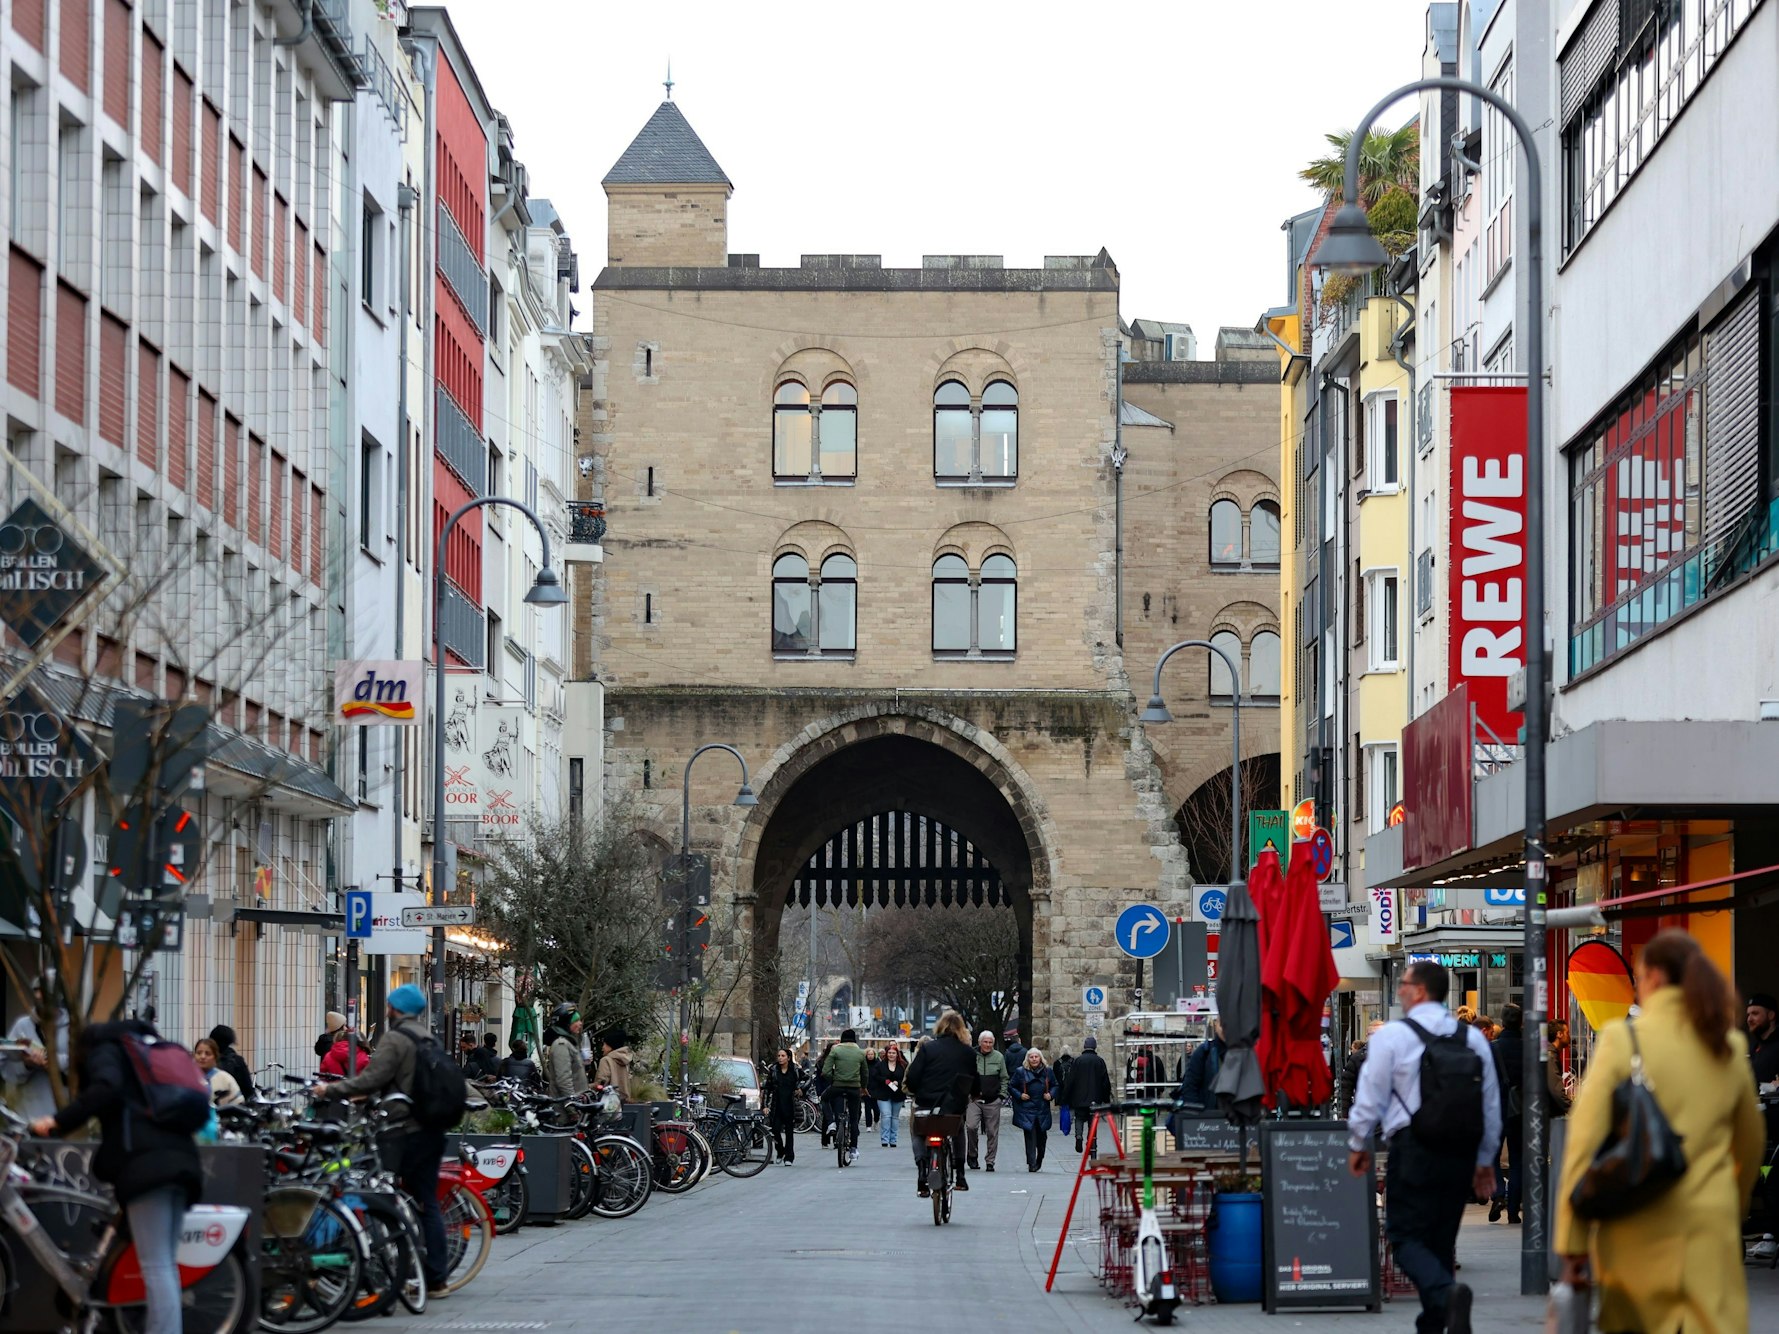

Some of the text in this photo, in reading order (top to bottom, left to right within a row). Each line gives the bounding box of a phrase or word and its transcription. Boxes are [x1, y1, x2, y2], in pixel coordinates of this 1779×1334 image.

[1461, 453, 1523, 677] REWE
[354, 670, 407, 702] dm
[446, 793, 477, 803] OOR
[483, 814, 519, 825] BOOR
[1256, 815, 1284, 829] THAI
[351, 897, 367, 932] P
[1297, 1282, 1331, 1291] ORIGINAL
